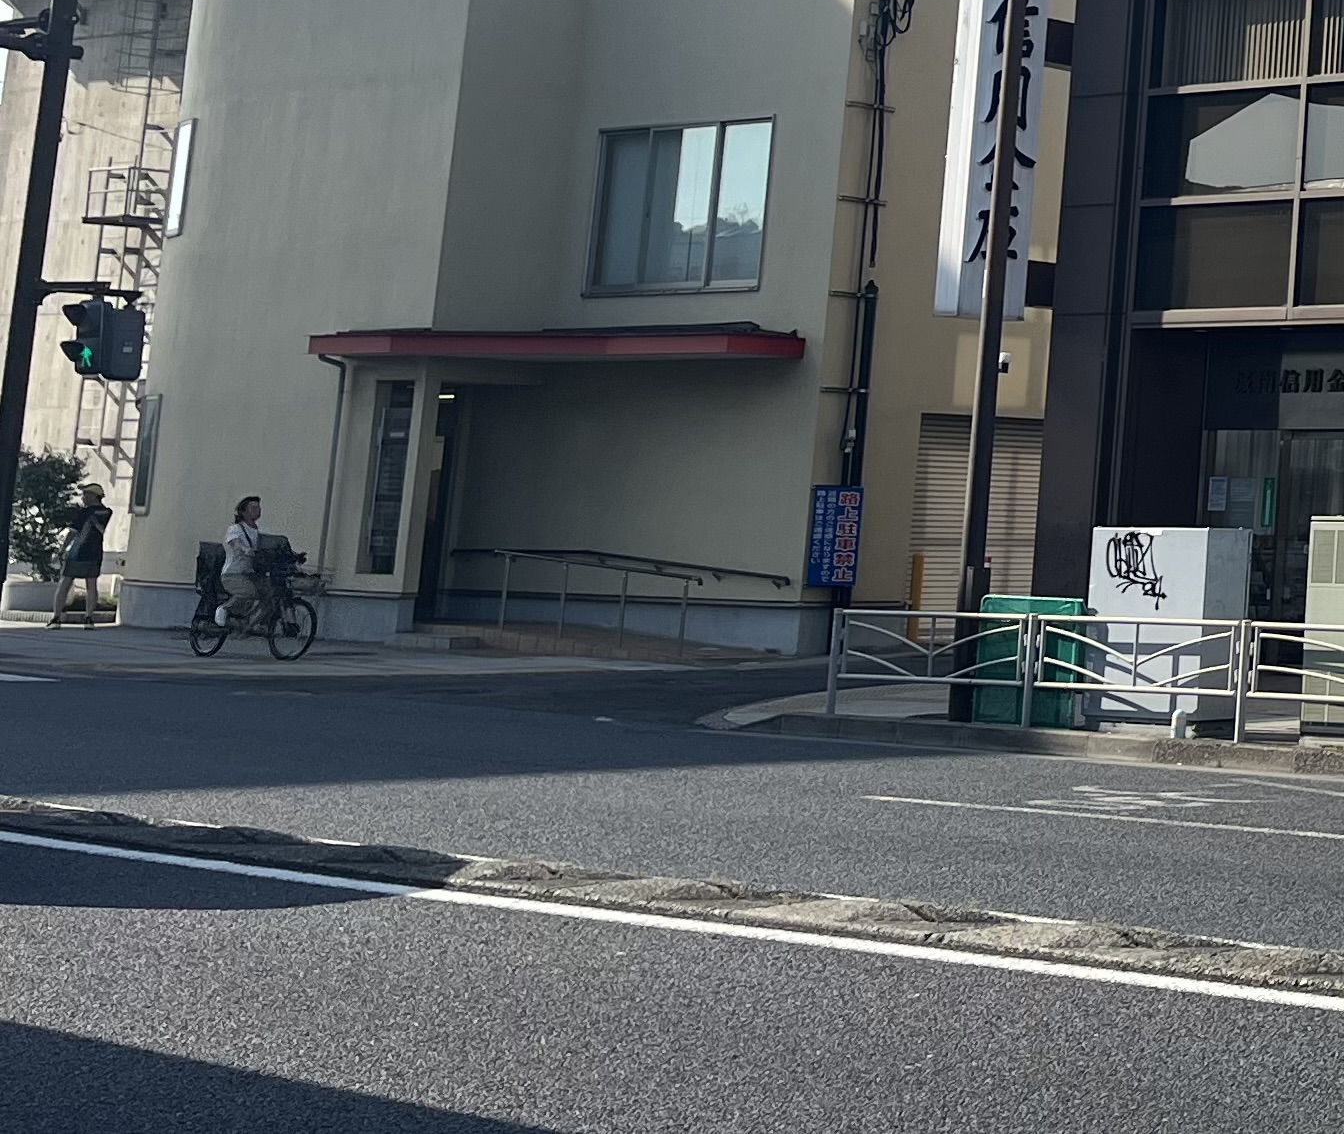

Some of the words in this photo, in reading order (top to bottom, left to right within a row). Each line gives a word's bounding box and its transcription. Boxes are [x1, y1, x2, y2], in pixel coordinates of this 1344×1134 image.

[832, 491, 860, 582] 路上駐車禁止
